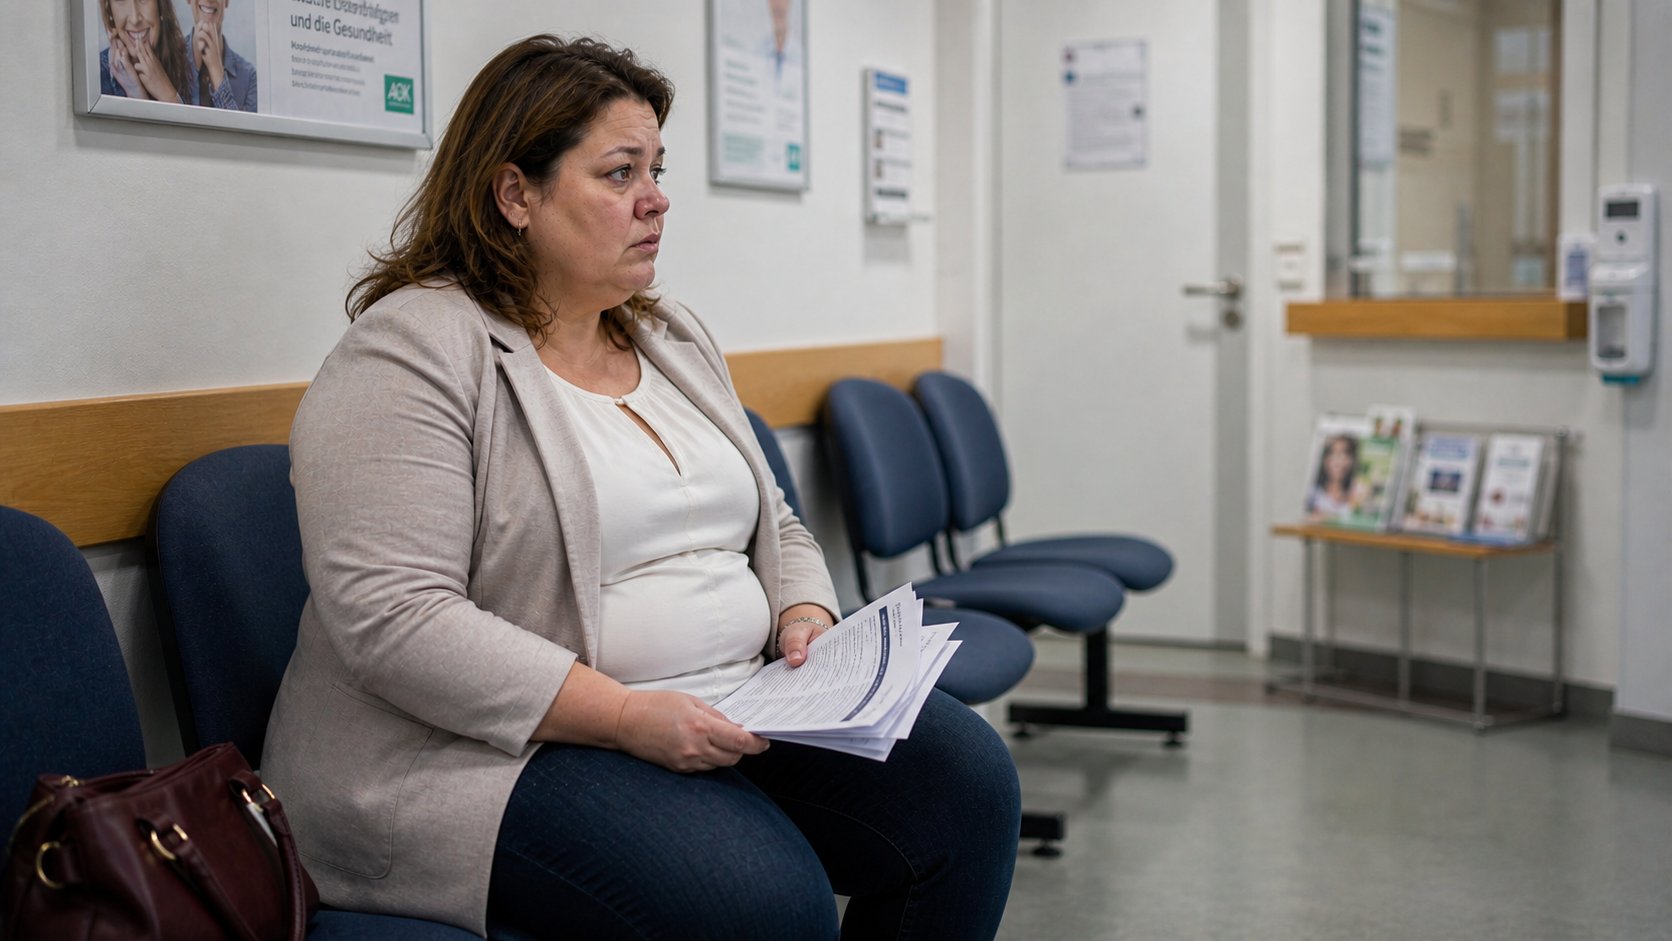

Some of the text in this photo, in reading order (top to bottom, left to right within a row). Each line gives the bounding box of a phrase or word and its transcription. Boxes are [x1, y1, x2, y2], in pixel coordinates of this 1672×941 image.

[290, 13, 311, 30] und
[314, 15, 331, 34] die
[387, 81, 412, 103] AOK
